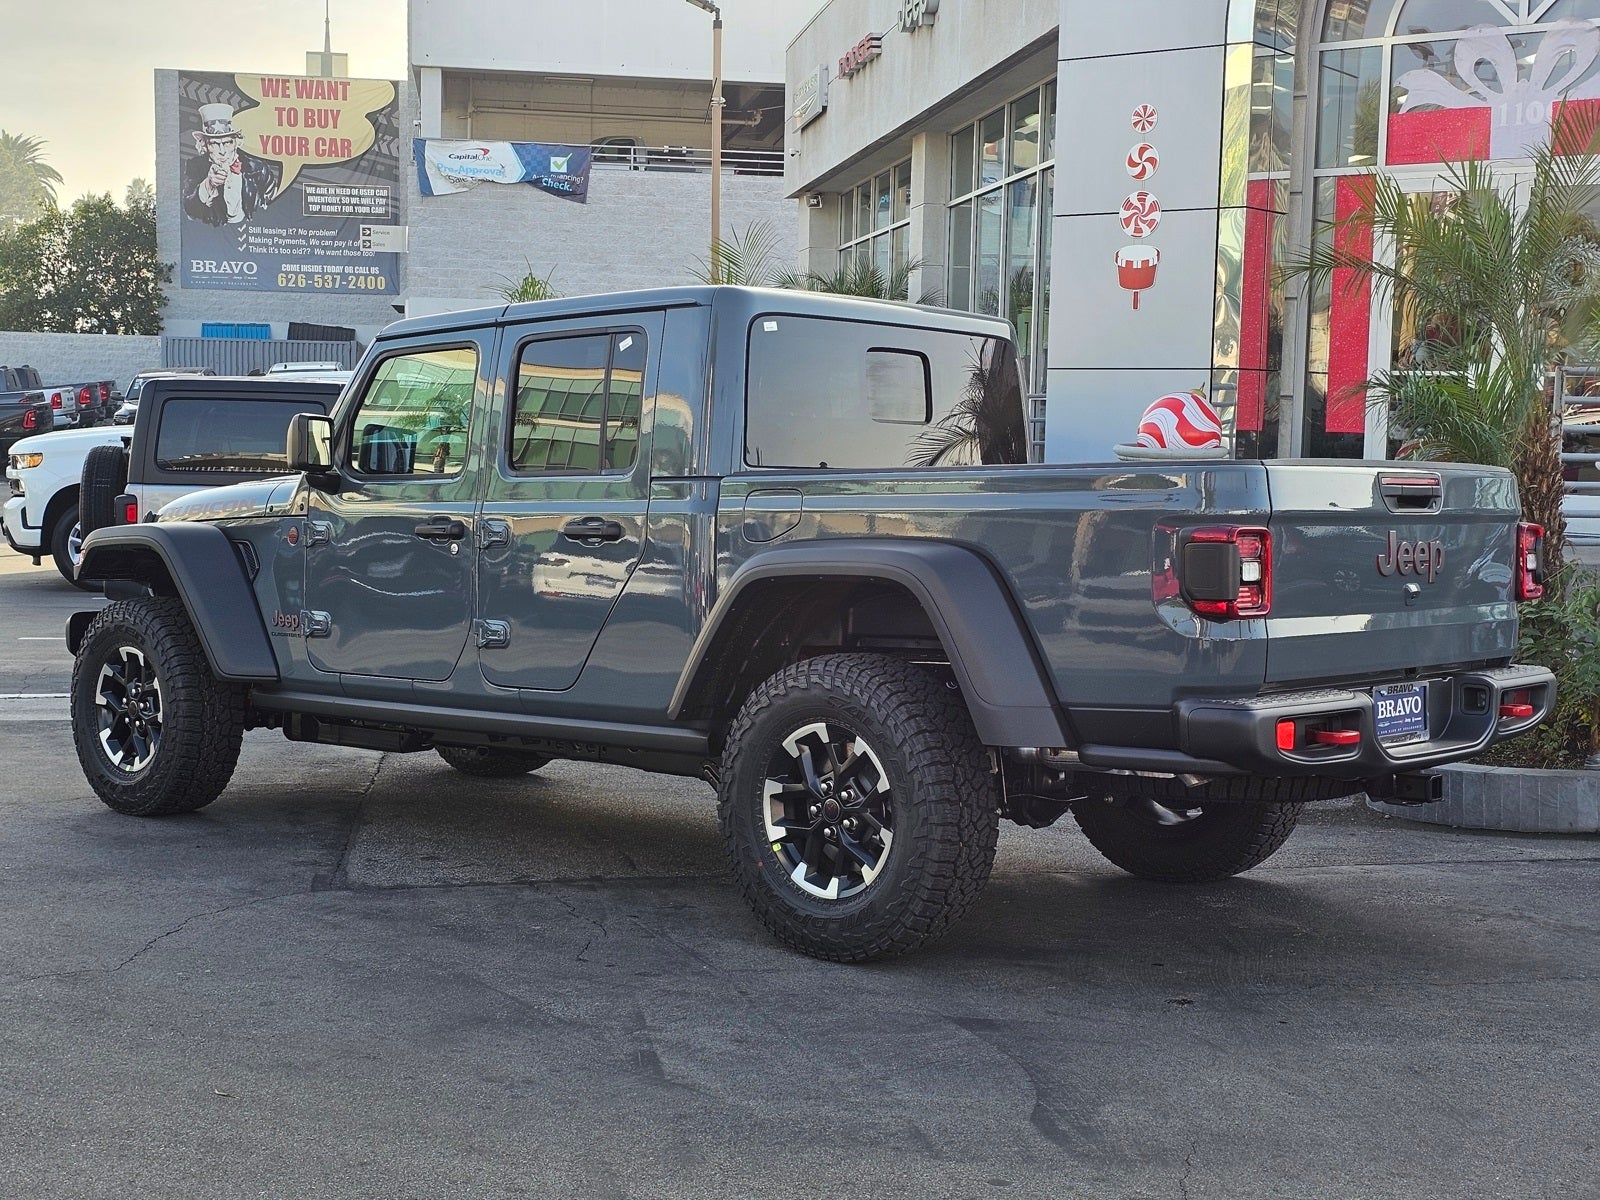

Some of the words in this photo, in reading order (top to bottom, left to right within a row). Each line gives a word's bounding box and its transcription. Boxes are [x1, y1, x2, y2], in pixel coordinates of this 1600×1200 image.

[261, 78, 290, 98] WE
[295, 79, 350, 101] WANT
[275, 107, 298, 127] TO
[304, 108, 341, 129] BUY
[259, 135, 309, 157] YOUR
[315, 137, 352, 158] CAR
[328, 187, 336, 195] IN
[542, 178, 572, 191] Check.
[262, 226, 286, 236] leasing
[308, 228, 338, 237] problem!
[248, 236, 272, 245] Making
[334, 240, 346, 248] pay
[249, 246, 268, 254] Think
[268, 246, 278, 254] it's
[190, 260, 258, 274] BRAVO
[282, 264, 300, 272] COME
[300, 264, 322, 272] INSIDE
[323, 265, 344, 274] TODAY
[344, 266, 354, 274] OR
[354, 266, 370, 274] CALL
[278, 273, 386, 290] 626-537-2400
[1376, 530, 1445, 583] Jeep
[271, 609, 300, 631] Jeep
[1388, 684, 1414, 694] BRAVO
[1377, 696, 1422, 719] BRAVO
